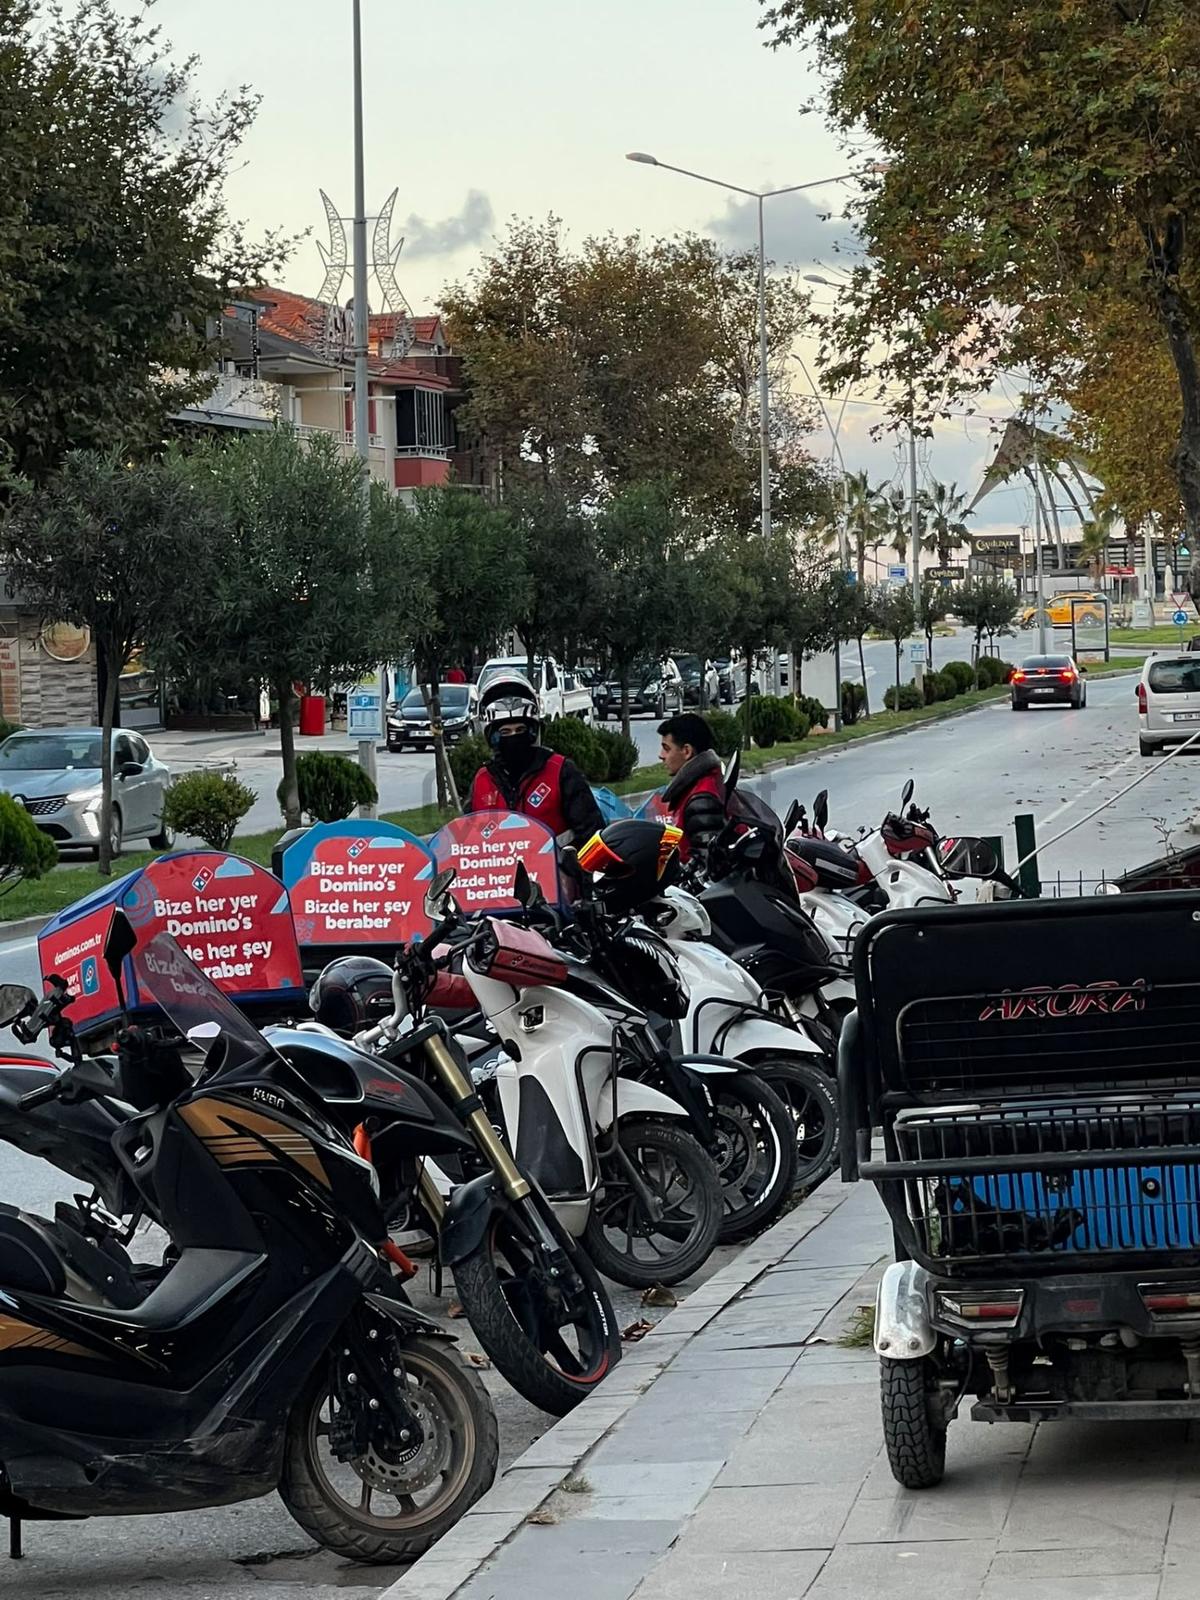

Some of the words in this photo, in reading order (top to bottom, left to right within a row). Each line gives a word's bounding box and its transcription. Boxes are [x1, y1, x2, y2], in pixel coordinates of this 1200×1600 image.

[451, 843, 479, 856] Bize
[482, 841, 506, 853] her
[508, 840, 530, 854] yer
[310, 861, 344, 876] Bize
[348, 861, 375, 875] her
[378, 863, 404, 878] yer
[460, 853, 524, 870] Domino's
[320, 877, 396, 893] Domino's
[489, 873, 512, 886] her
[466, 886, 515, 901] berabe
[153, 898, 192, 917] Bize
[195, 895, 226, 912] her
[229, 894, 258, 915] yer
[305, 899, 349, 914] Bizde
[353, 899, 380, 913] her
[384, 900, 411, 916] şey
[167, 912, 252, 937] Domino's
[325, 914, 391, 930] beraber
[54, 933, 102, 966] dominos.com.tr
[207, 943, 237, 960] her
[242, 940, 272, 960] şey
